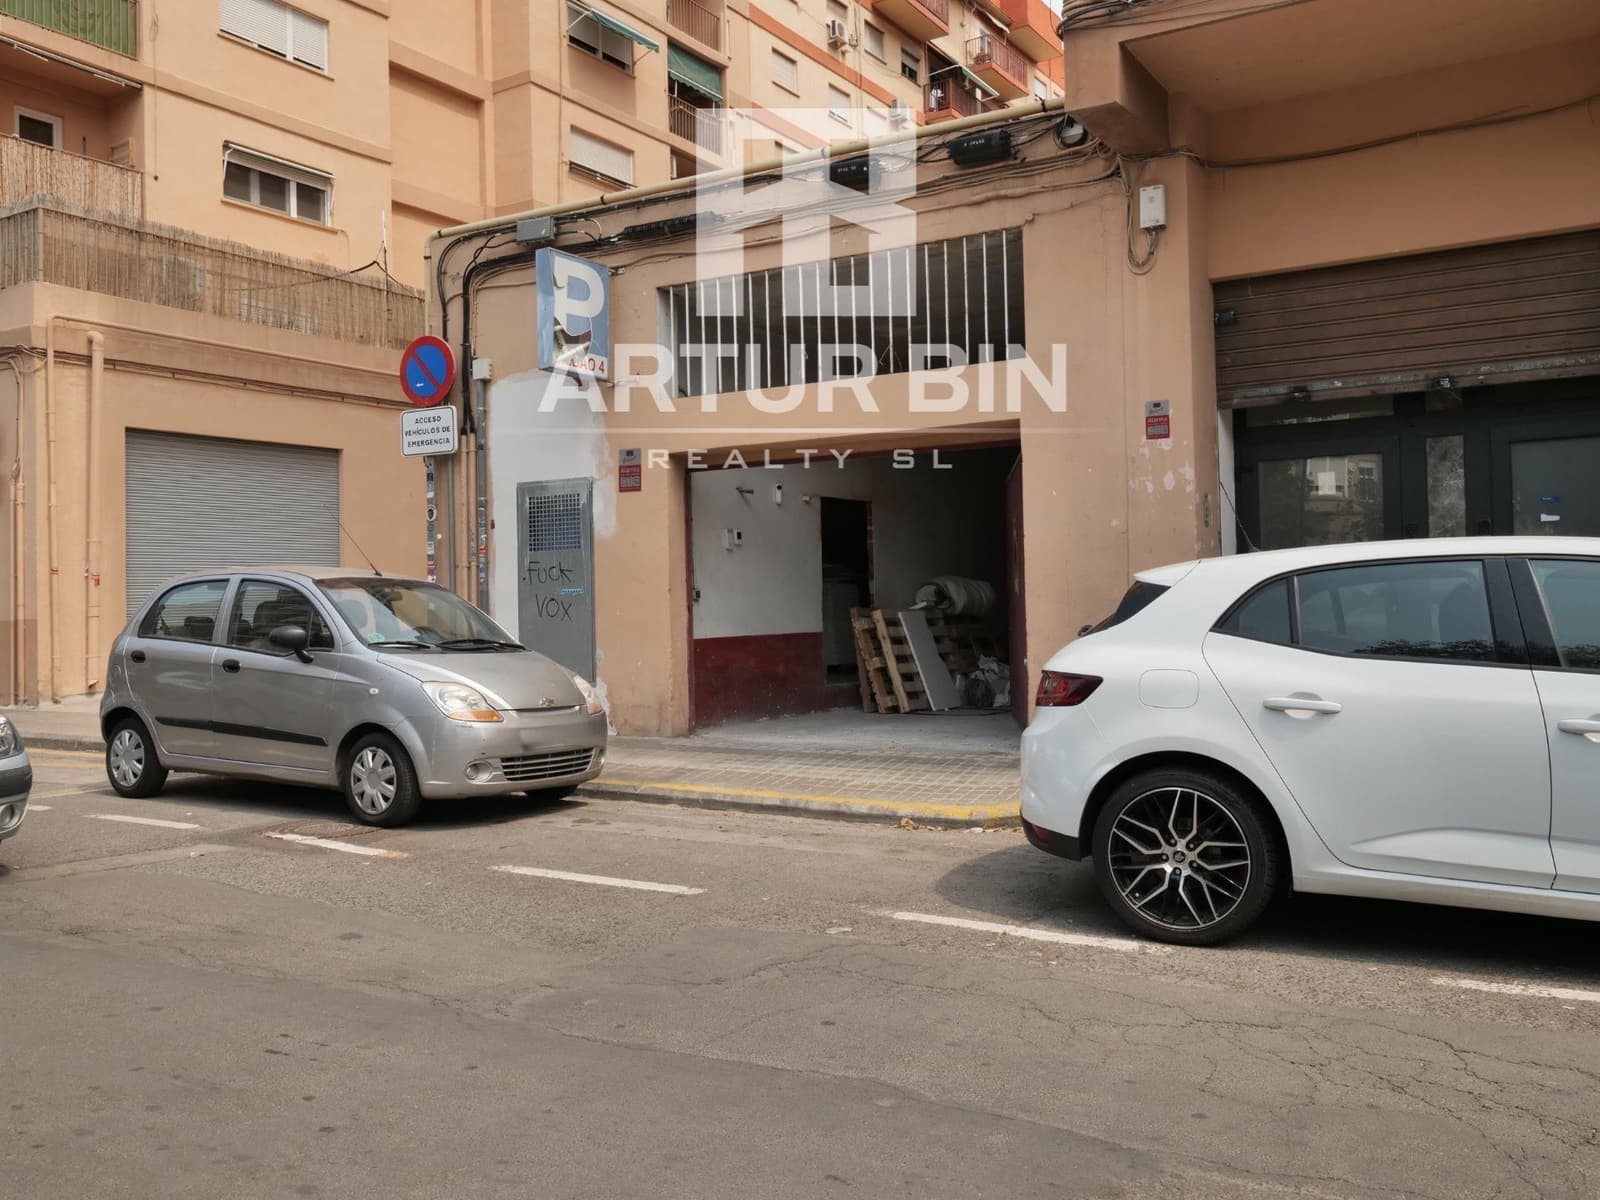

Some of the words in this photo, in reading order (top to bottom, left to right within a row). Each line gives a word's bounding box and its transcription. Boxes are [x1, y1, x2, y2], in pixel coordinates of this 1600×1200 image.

[553, 255, 605, 331] P
[415, 416, 442, 424] ACCESO
[408, 438, 450, 448] EMERGENCIA
[535, 593, 573, 622] VOX
